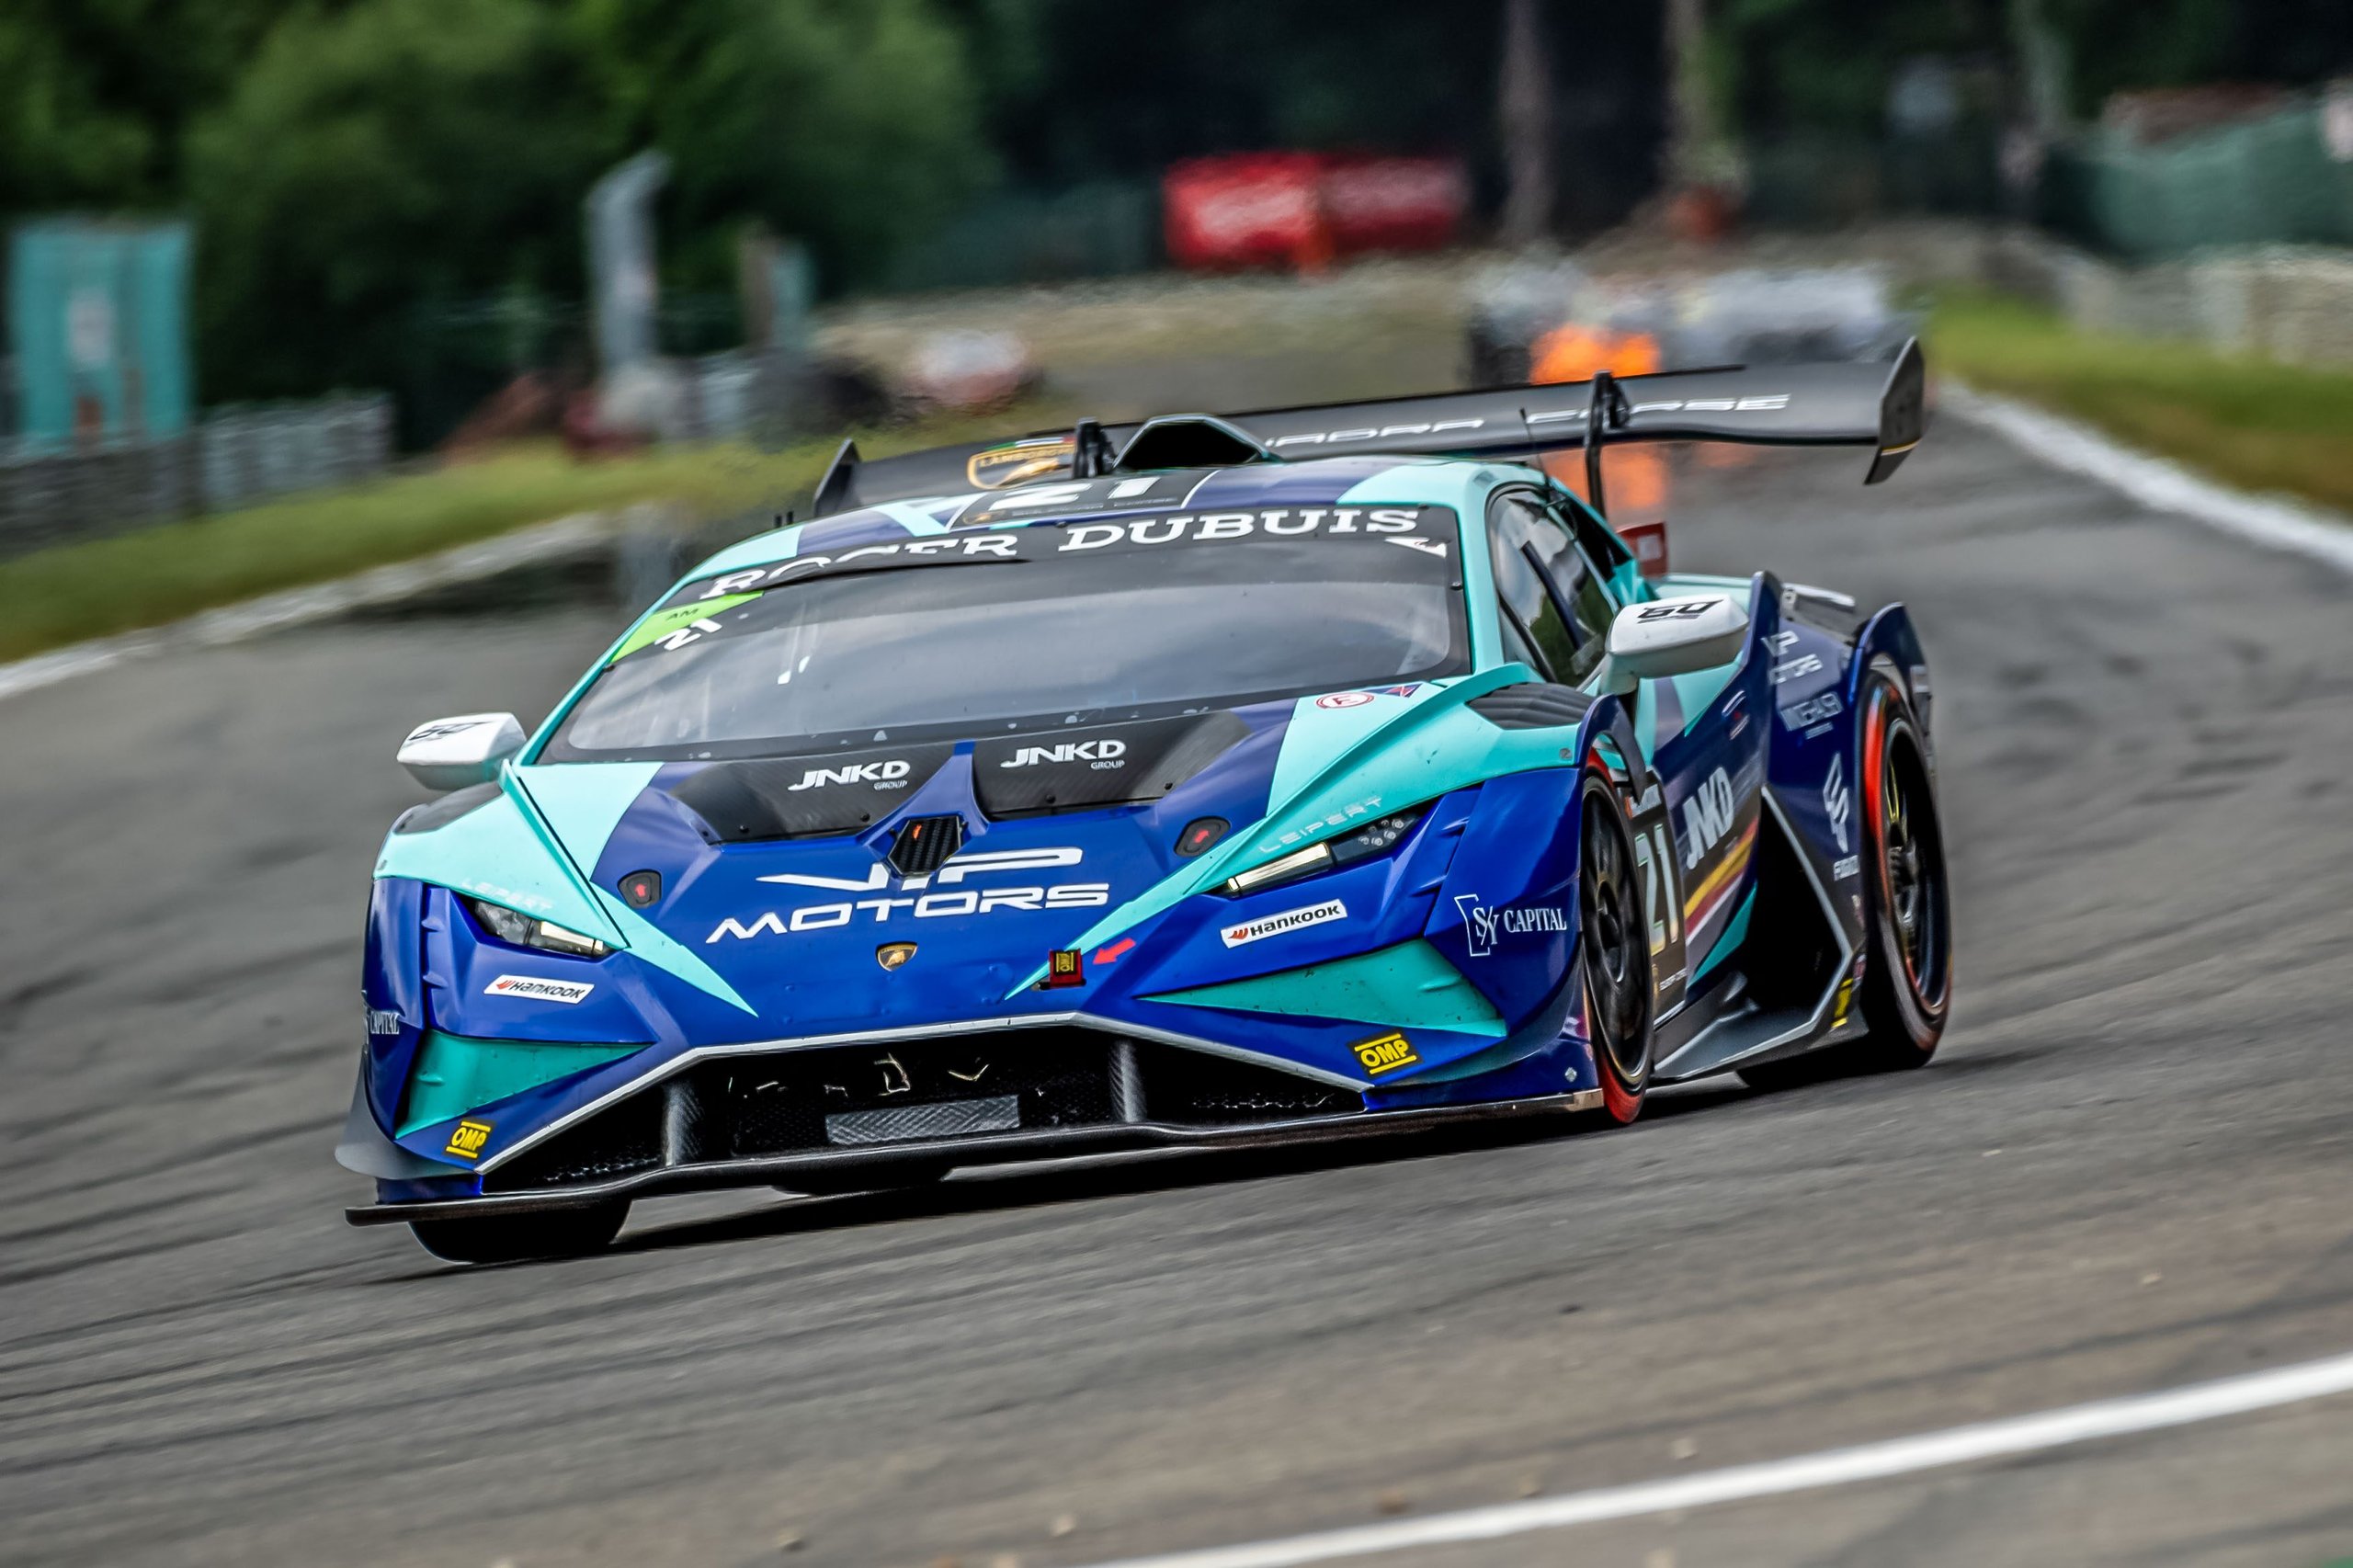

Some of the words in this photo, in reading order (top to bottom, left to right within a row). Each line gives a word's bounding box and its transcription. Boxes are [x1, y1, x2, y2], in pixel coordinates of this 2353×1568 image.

[1057, 508, 1418, 552] DUBUIS
[1001, 740, 1126, 768] JNKD
[1089, 757, 1125, 771] GROUP
[787, 760, 911, 791] JNKD
[873, 778, 908, 791] GROUP
[1258, 795, 1383, 854] LEIPERT
[1682, 767, 1735, 870] JNKD
[705, 882, 1109, 944] MOTORS
[1503, 907, 1567, 933] CAPITAL
[1360, 1040, 1409, 1069] OMP
[450, 1125, 486, 1151] OMP
